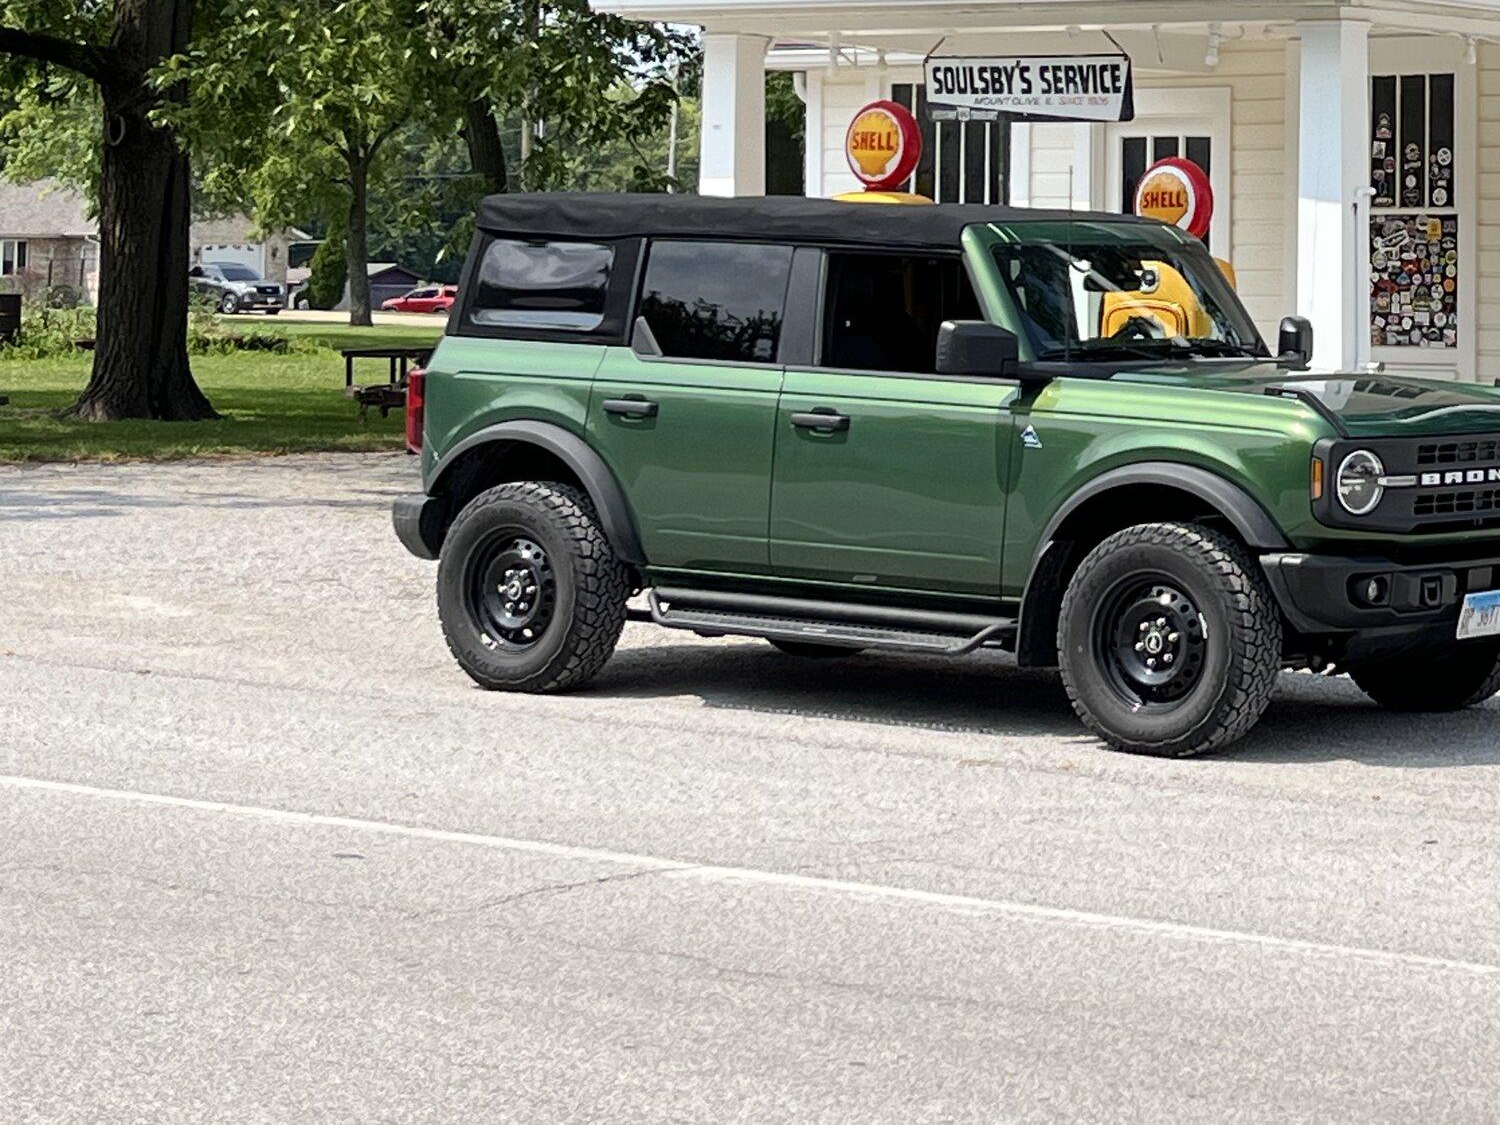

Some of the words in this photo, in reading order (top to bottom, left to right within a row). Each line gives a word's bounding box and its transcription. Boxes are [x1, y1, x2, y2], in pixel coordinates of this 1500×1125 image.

[932, 60, 1032, 95] SOULSBY'S
[1039, 63, 1122, 95] SERVICE
[852, 131, 895, 151] SHELL
[1143, 191, 1184, 208] SHELL
